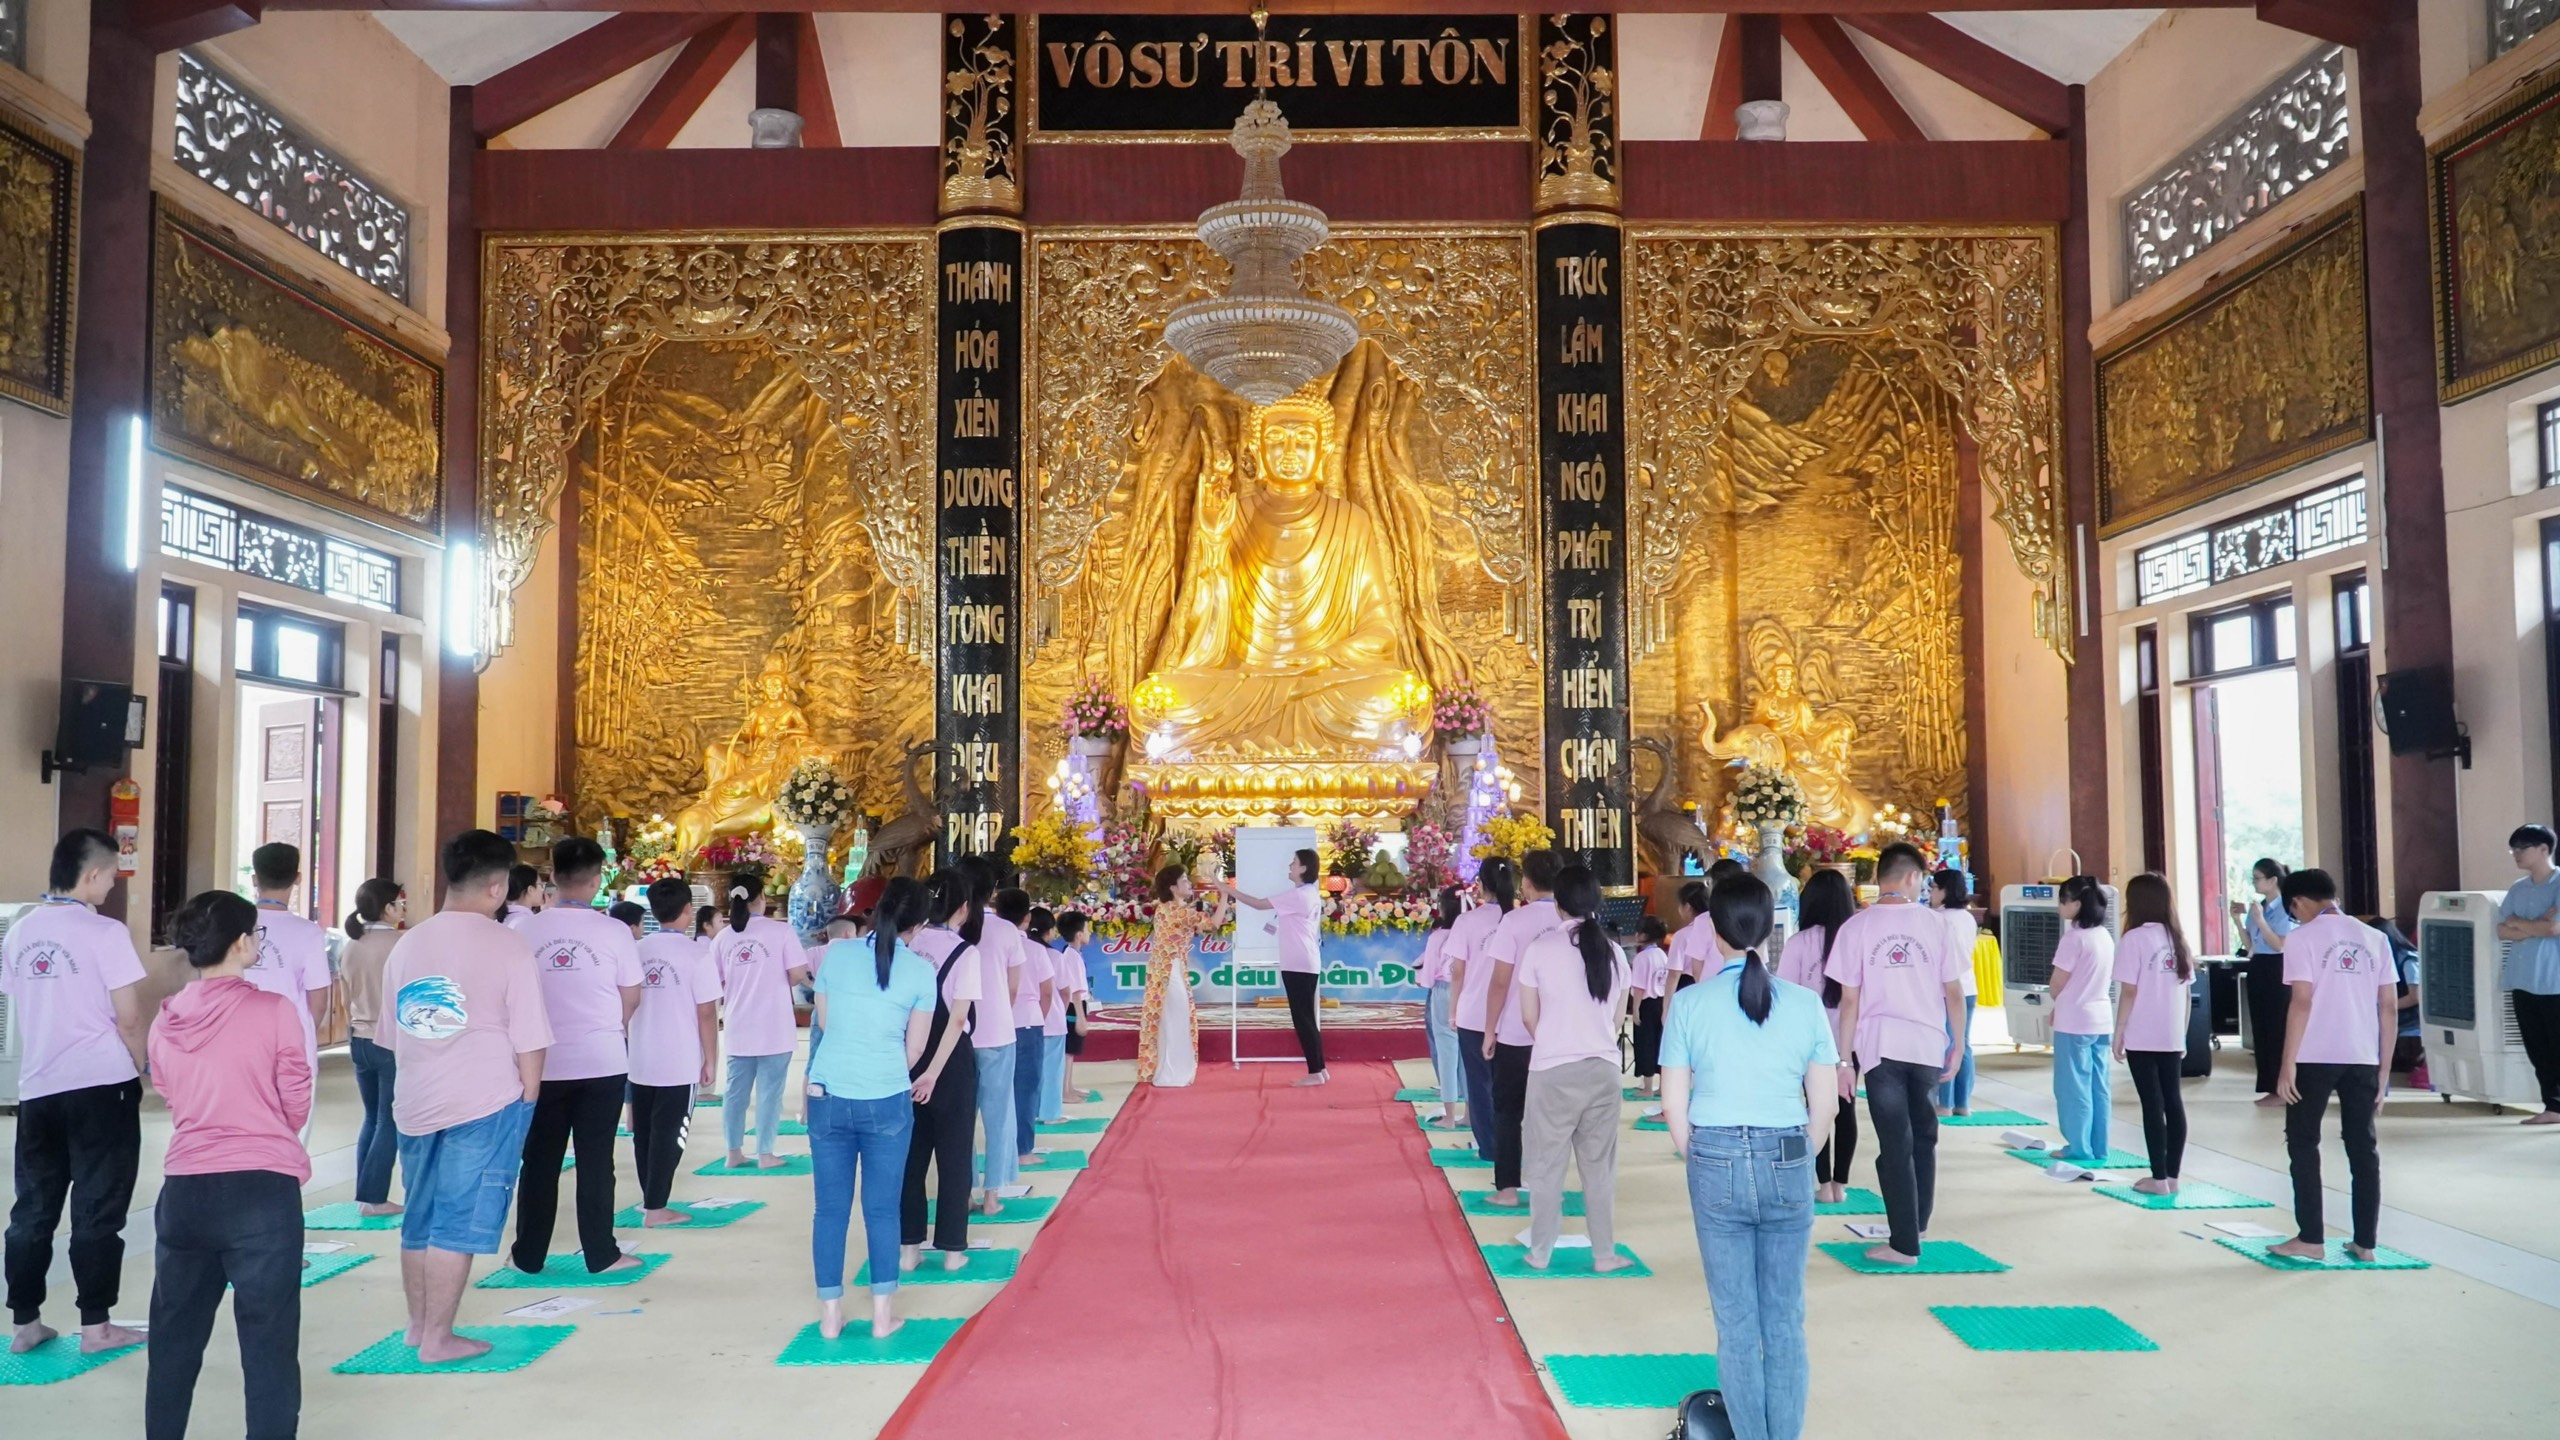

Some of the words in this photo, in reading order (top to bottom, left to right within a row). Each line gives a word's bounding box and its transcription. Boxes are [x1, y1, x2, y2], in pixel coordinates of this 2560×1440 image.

[1047, 30, 1124, 88] VÔ
[1129, 32, 1209, 88] SƯ
[1215, 28, 1318, 87] TRÍ
[1324, 39, 1385, 87] VI
[1392, 27, 1510, 86] TÔN
[946, 261, 1011, 306] THANH
[1555, 249, 1608, 300] TRÚC
[955, 320, 999, 373] HÓA
[1561, 316, 1603, 369] LÂM
[953, 376, 1000, 438] XIỂN
[1558, 392, 1608, 437] KHAI
[944, 467, 1013, 509] DƯƠNG
[1560, 453, 1607, 508] NGỘ
[947, 518, 1006, 580] THIỀN
[1558, 522, 1612, 576] PHẬT
[948, 595, 1005, 645] TÔNG
[1567, 591, 1604, 643] TRÍ
[953, 674, 1002, 718] KHAI
[1562, 650, 1613, 709] HIỂN
[1561, 730, 1617, 784] CHÂN
[949, 804, 1004, 857] PHÁP
[1560, 792, 1622, 852] THIỀN
